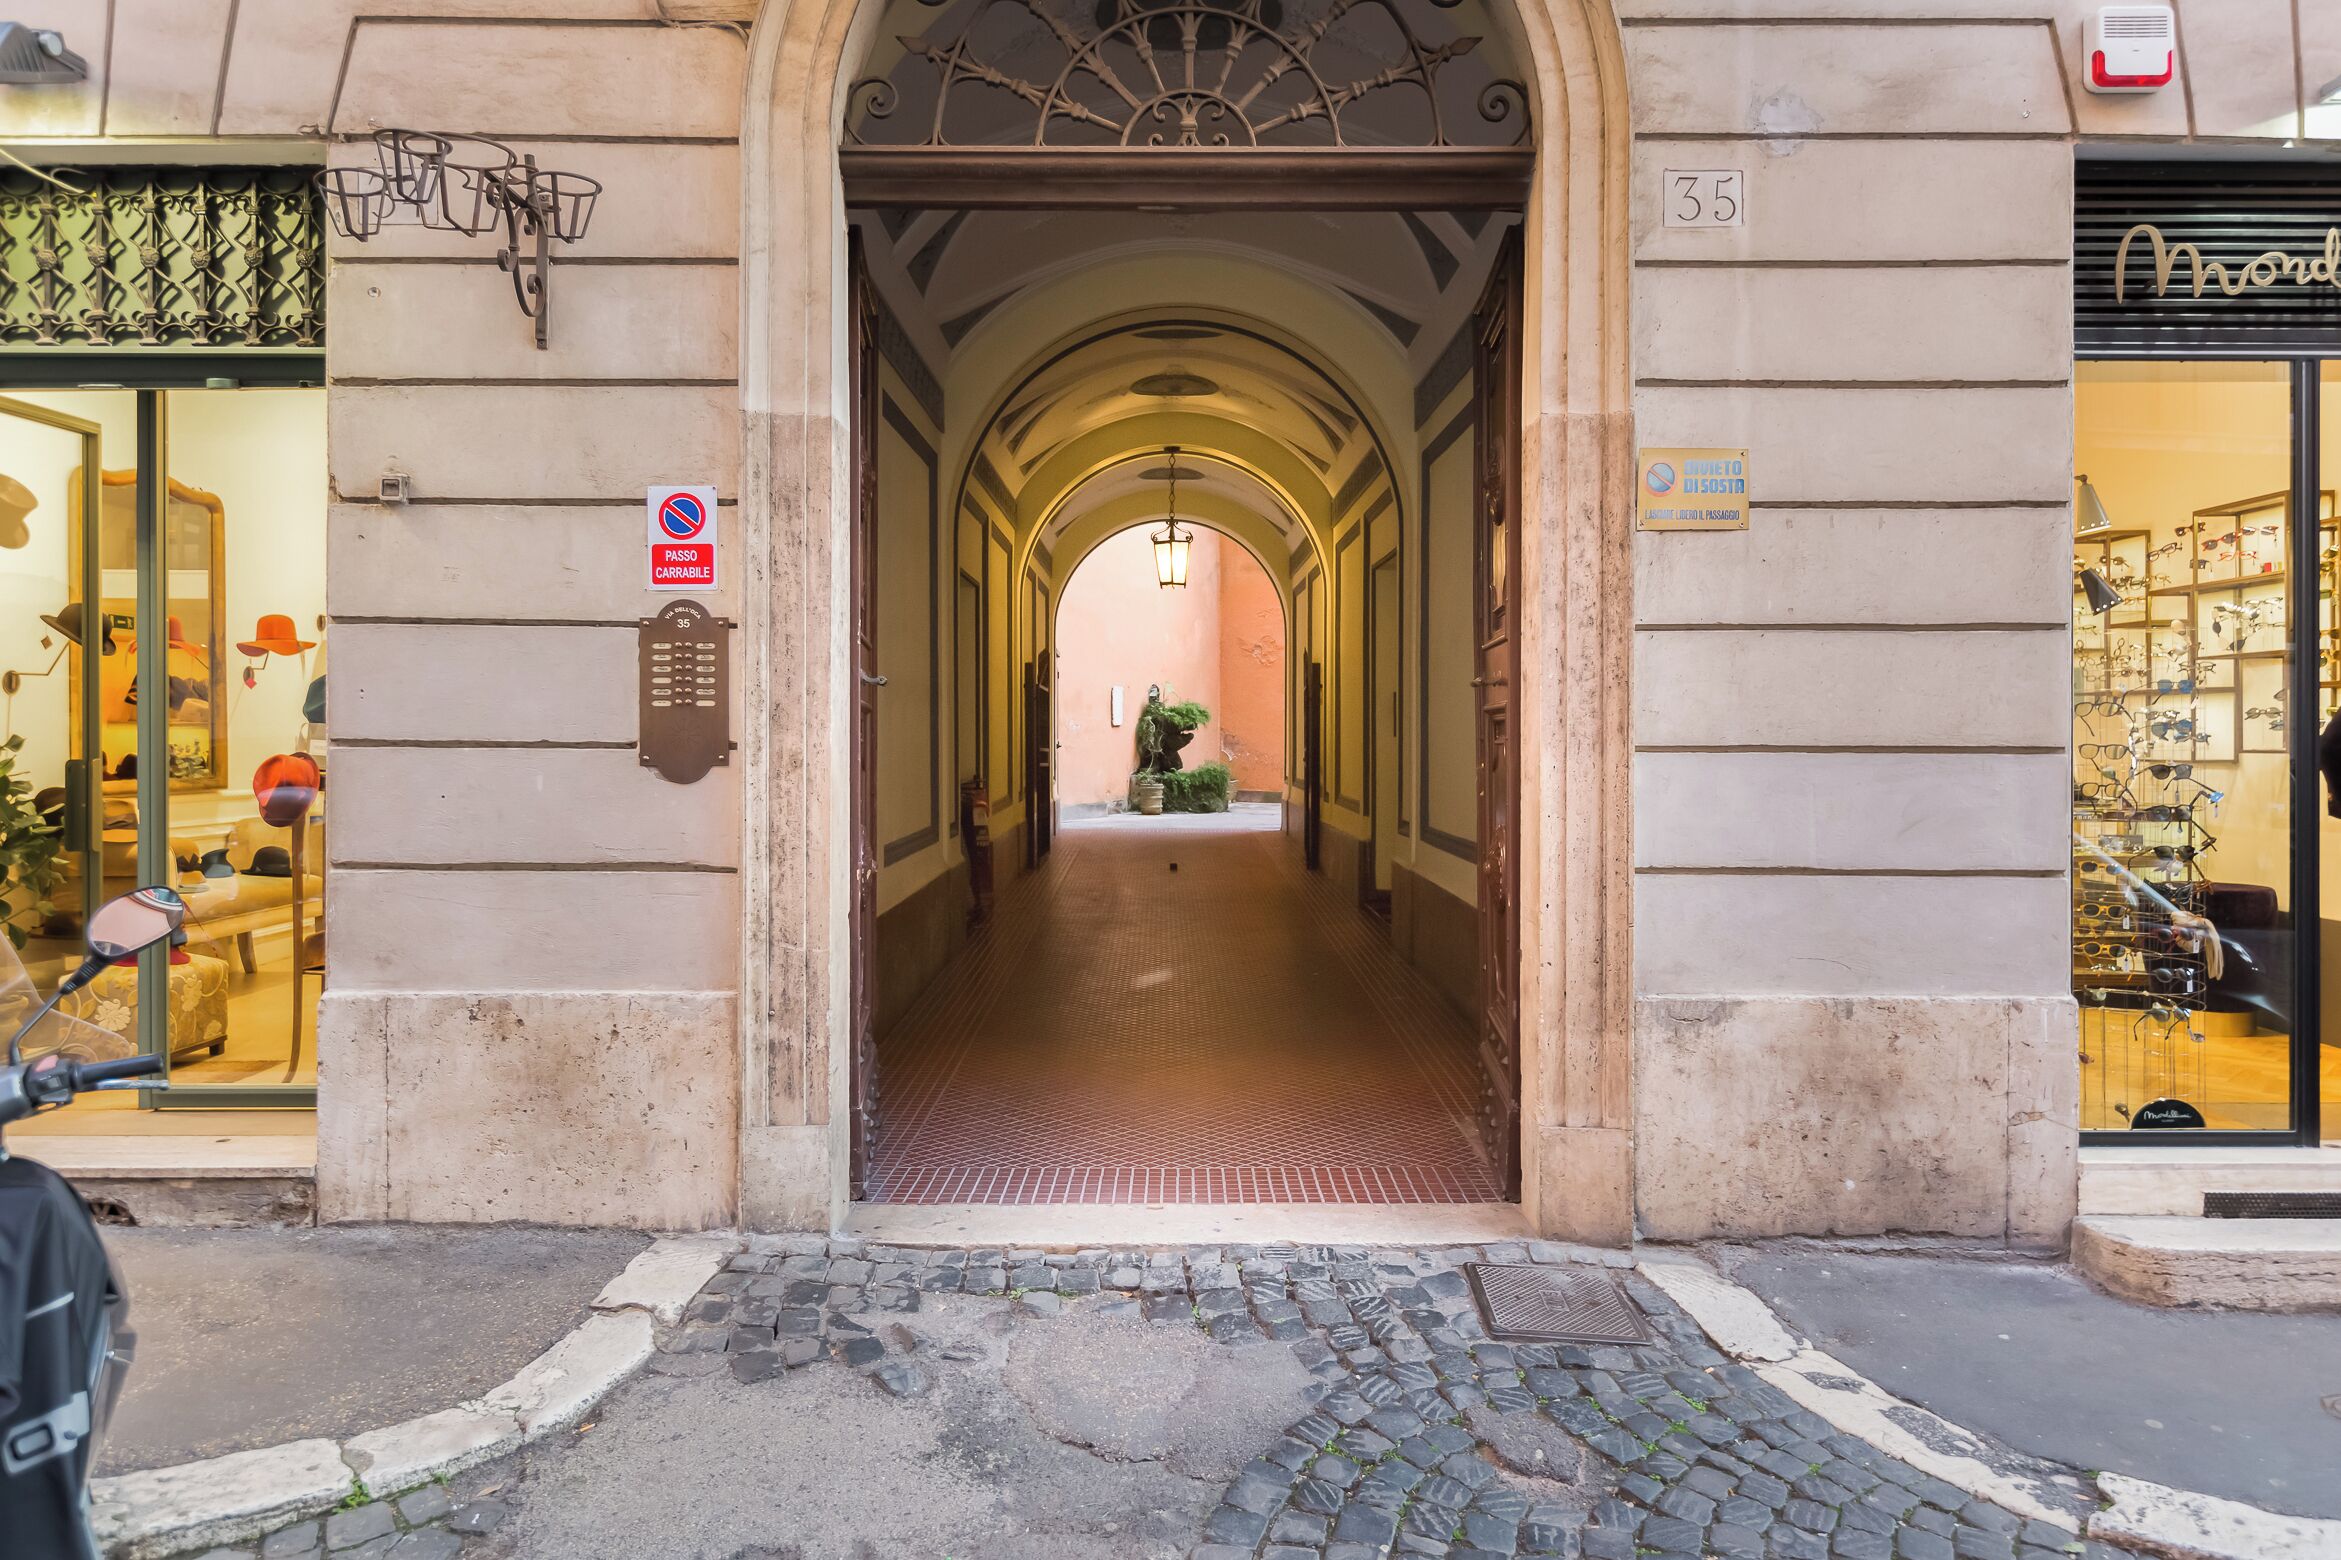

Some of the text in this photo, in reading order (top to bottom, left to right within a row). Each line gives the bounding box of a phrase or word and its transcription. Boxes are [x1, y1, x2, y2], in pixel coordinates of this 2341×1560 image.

[1674, 177, 1736, 221] 35
[1684, 460, 1742, 475] DIVIETO
[1684, 478, 1745, 494] DI SOSTA
[1676, 509, 1697, 520] LIBERO
[1699, 510, 1705, 520] IL
[1706, 510, 1740, 520] PASSAGGIO
[665, 550, 698, 561] PASSO
[656, 566, 710, 578] CARRABILE
[665, 607, 701, 619] VIA DELL'OCA
[677, 618, 690, 628] 35
